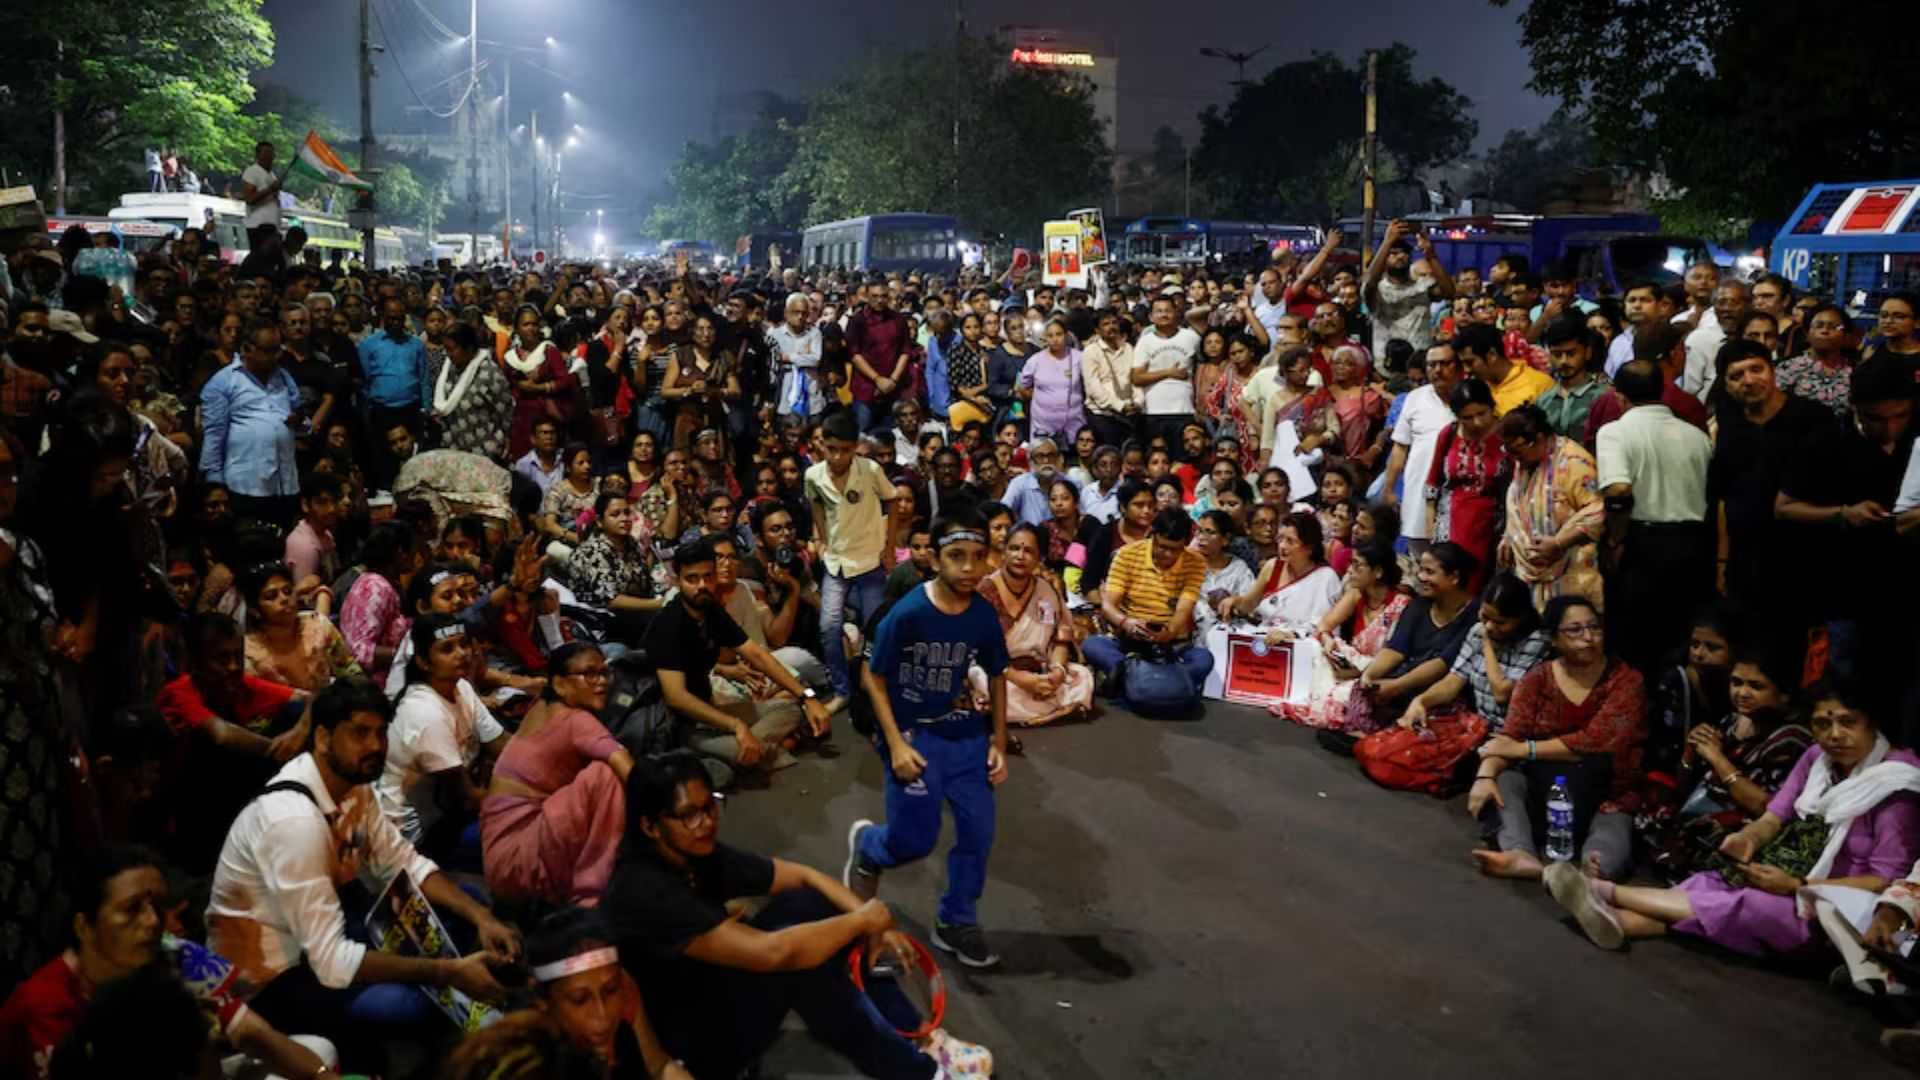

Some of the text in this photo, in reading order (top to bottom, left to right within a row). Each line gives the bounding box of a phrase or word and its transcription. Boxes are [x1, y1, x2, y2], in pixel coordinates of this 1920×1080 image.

[1058, 52, 1095, 66] HOTEL
[1782, 248, 1809, 281] KP
[913, 641, 967, 667] POLO
